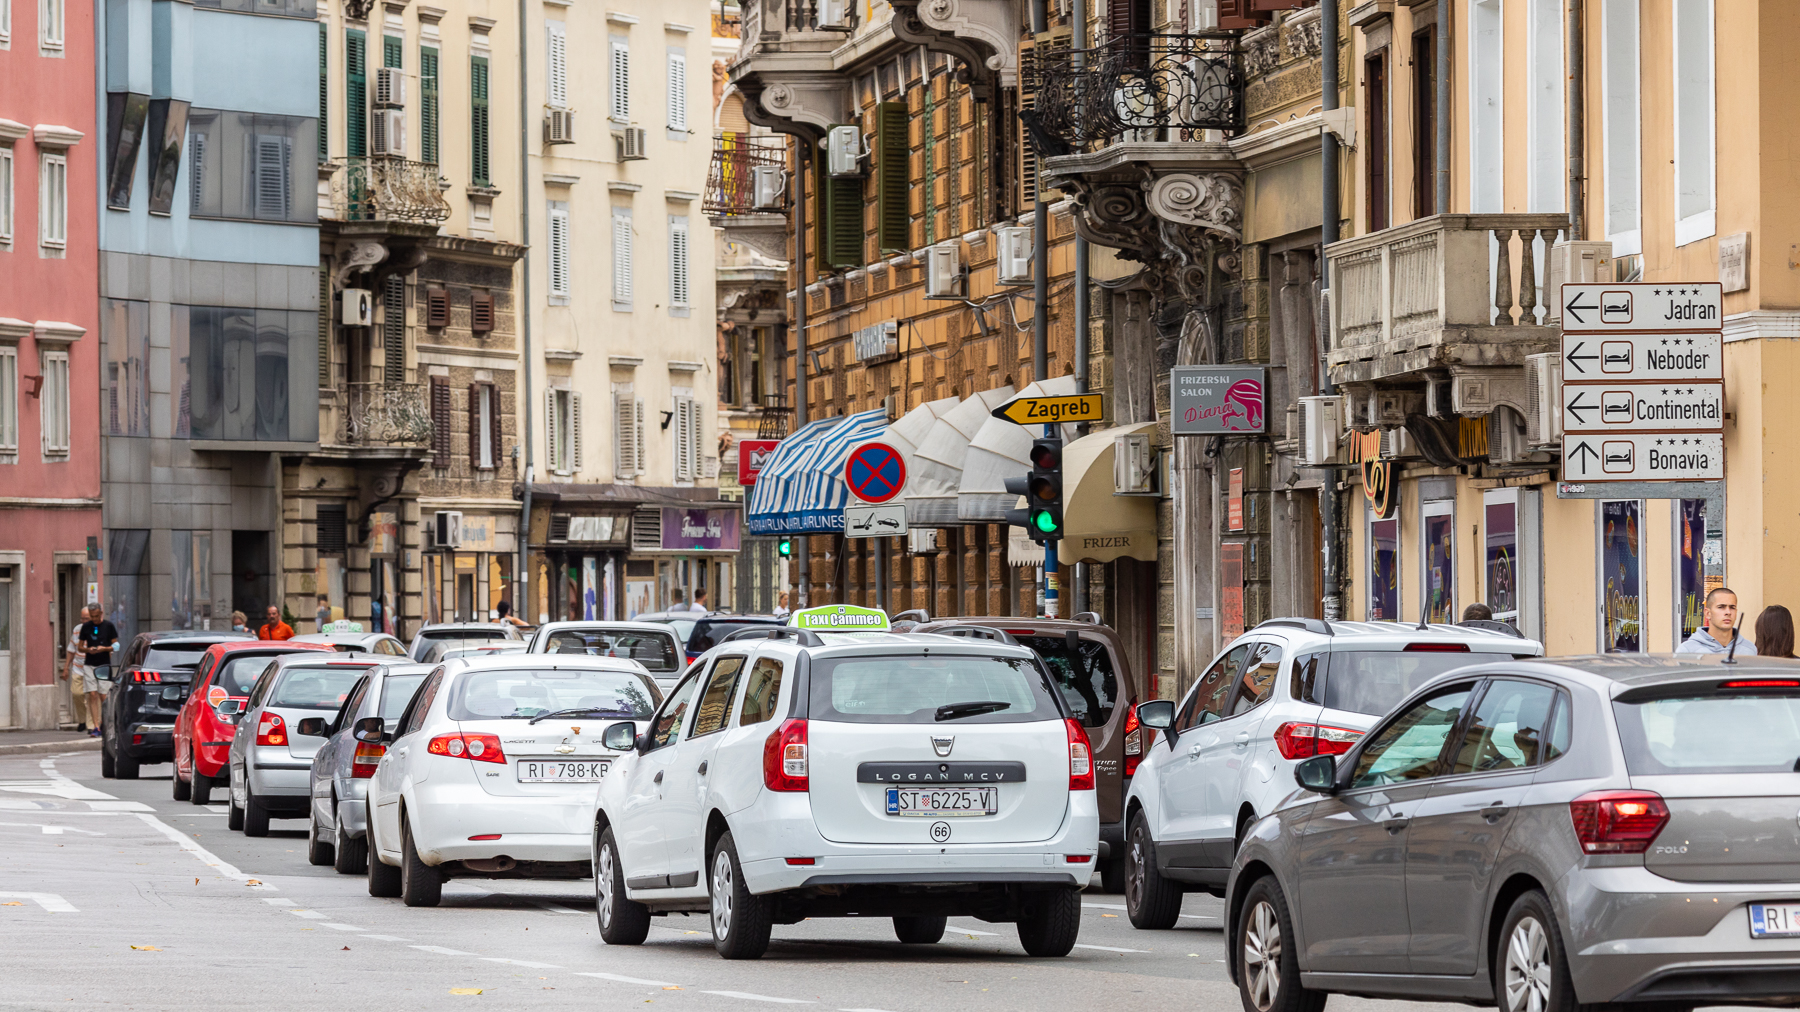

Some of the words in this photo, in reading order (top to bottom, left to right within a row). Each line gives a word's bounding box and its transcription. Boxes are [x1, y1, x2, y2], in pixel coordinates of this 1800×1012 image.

[1664, 299, 1716, 320] Jadran
[1647, 349, 1710, 370] Neboder
[1180, 375, 1230, 385] FRIZERSKI
[1180, 388, 1213, 397] SALON
[1027, 398, 1090, 421] Zagreb
[1184, 402, 1233, 423] Diana
[1636, 398, 1720, 420] Continental
[1458, 414, 1490, 458] AUTOMA
[1649, 449, 1709, 470] Bonavia
[802, 514, 844, 529] AIRLINES
[1083, 536, 1131, 549] FRIZER
[803, 613, 829, 627] Taxi
[830, 613, 882, 627] Cammeo
[529, 763, 544, 778] RI
[875, 773, 949, 781] LOGAN
[963, 773, 1005, 781] MCV
[900, 792, 919, 809] ST
[931, 791, 990, 809] 6225-V
[934, 826, 948, 837] 66
[1656, 846, 1688, 855] POLO
[1766, 908, 1789, 930] RI
